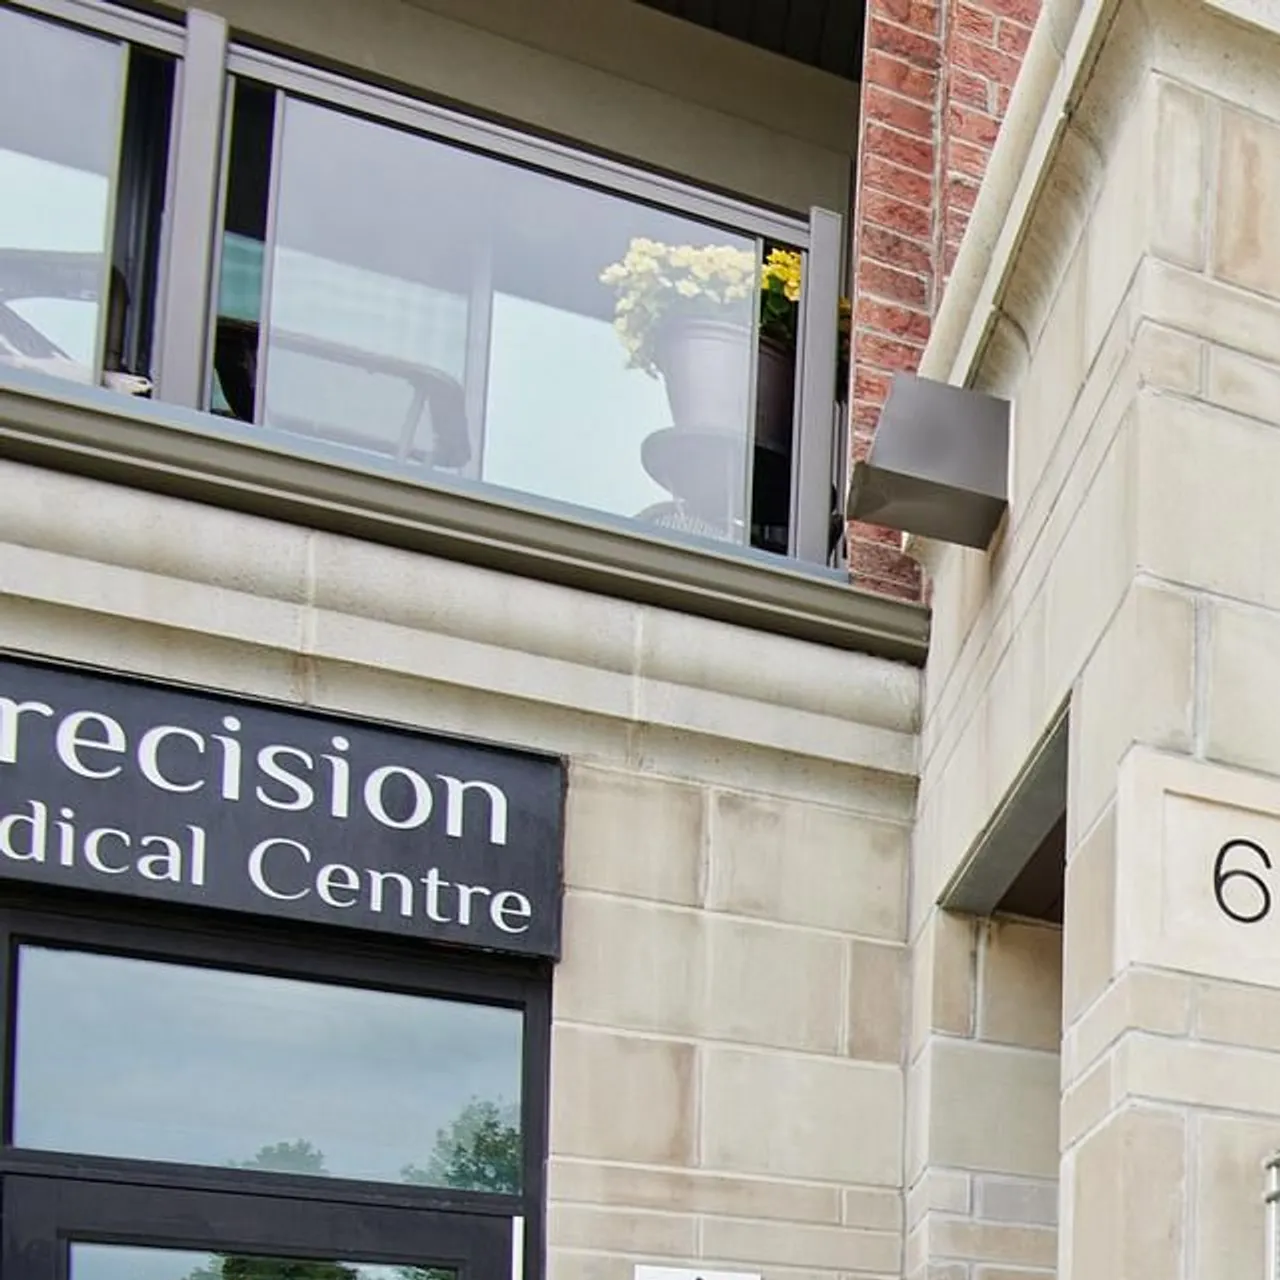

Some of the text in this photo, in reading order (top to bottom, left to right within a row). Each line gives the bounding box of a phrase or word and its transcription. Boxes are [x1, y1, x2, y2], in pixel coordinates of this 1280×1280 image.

[0, 698, 508, 845] recision
[0, 801, 532, 934] dical Centre
